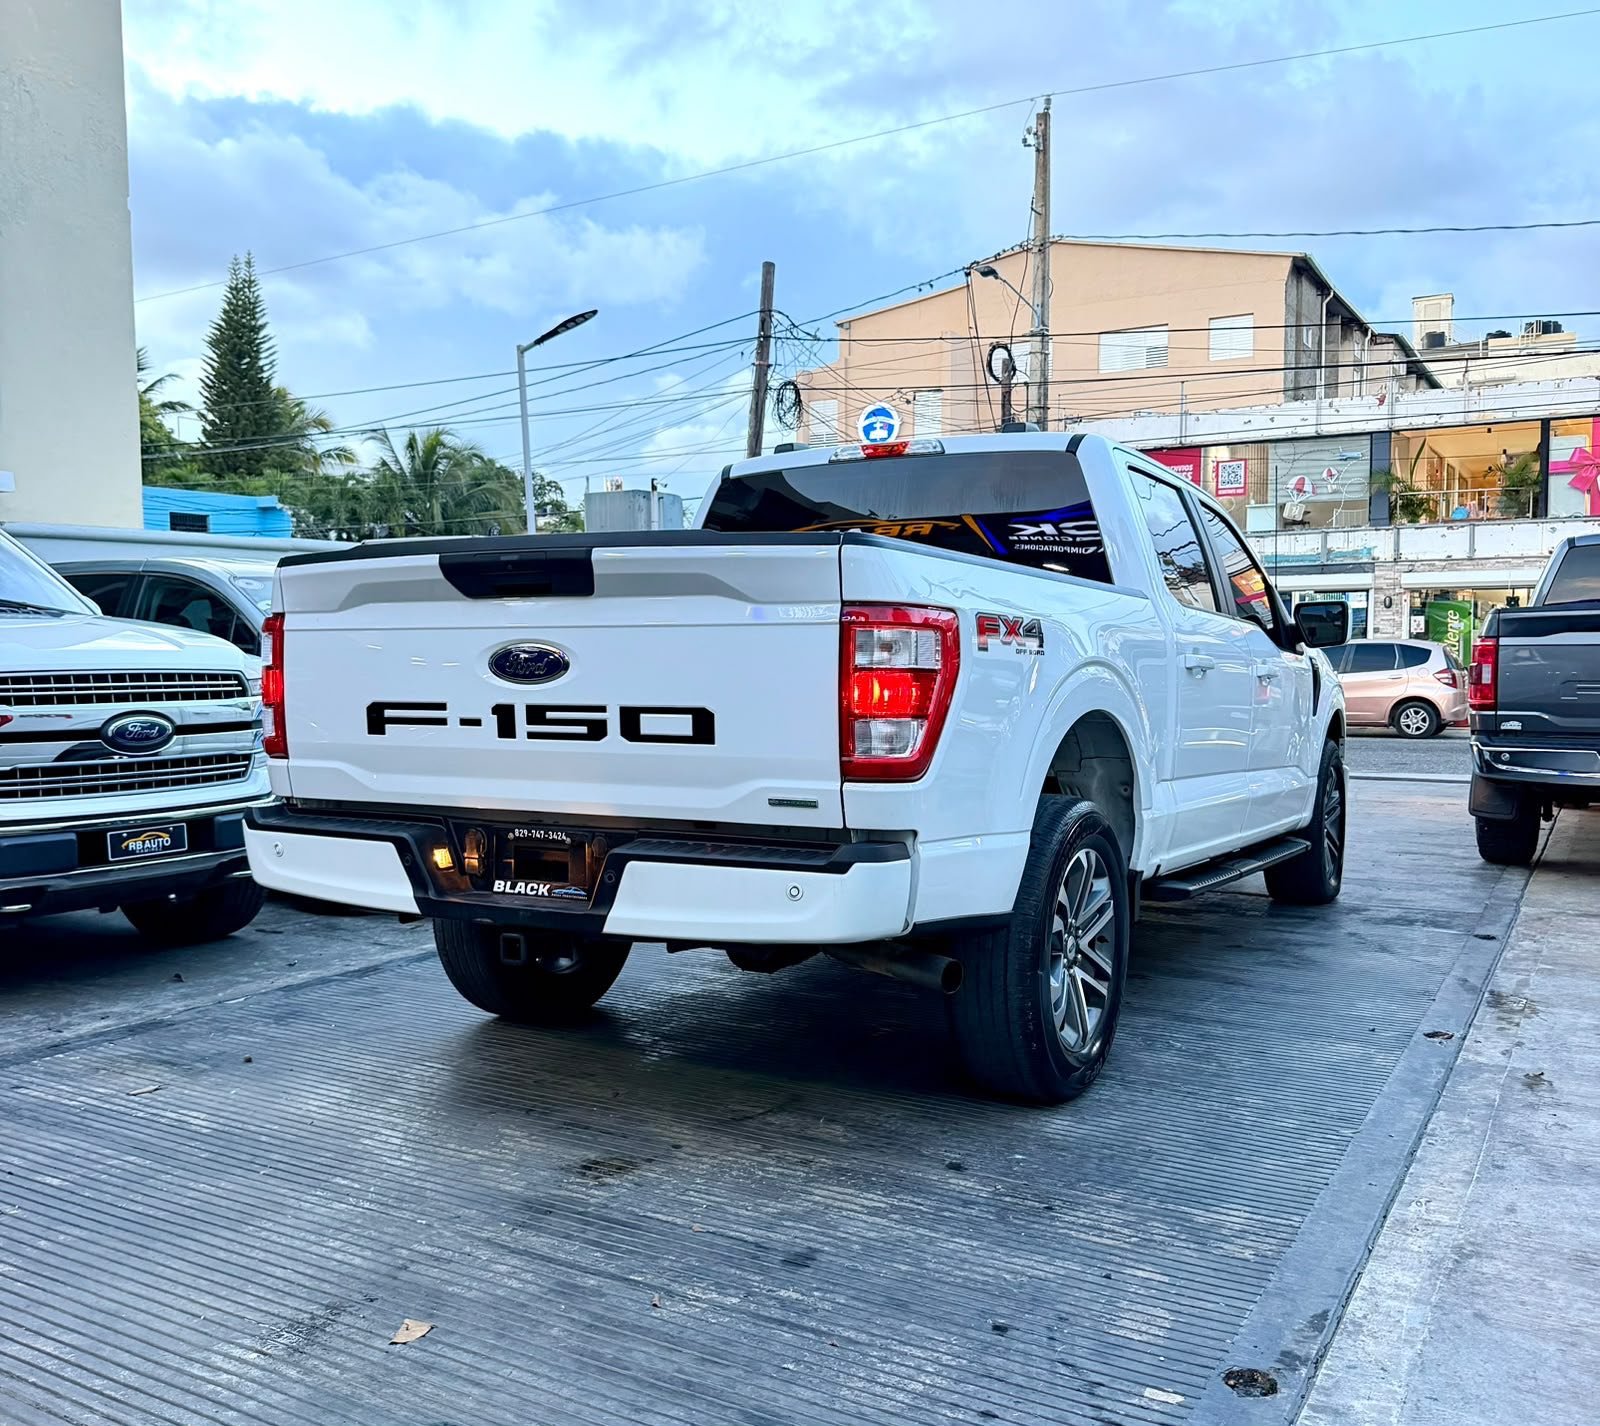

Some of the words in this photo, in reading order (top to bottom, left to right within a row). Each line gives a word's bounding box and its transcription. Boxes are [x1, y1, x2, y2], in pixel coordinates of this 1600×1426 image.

[975, 612, 1045, 652] FX4
[505, 651, 548, 675] Ford
[126, 722, 159, 738] Ford
[366, 701, 716, 745] F-150
[514, 828, 567, 841] 829-747-3424
[144, 837, 171, 849] AUTO
[493, 880, 551, 896] BLACK
